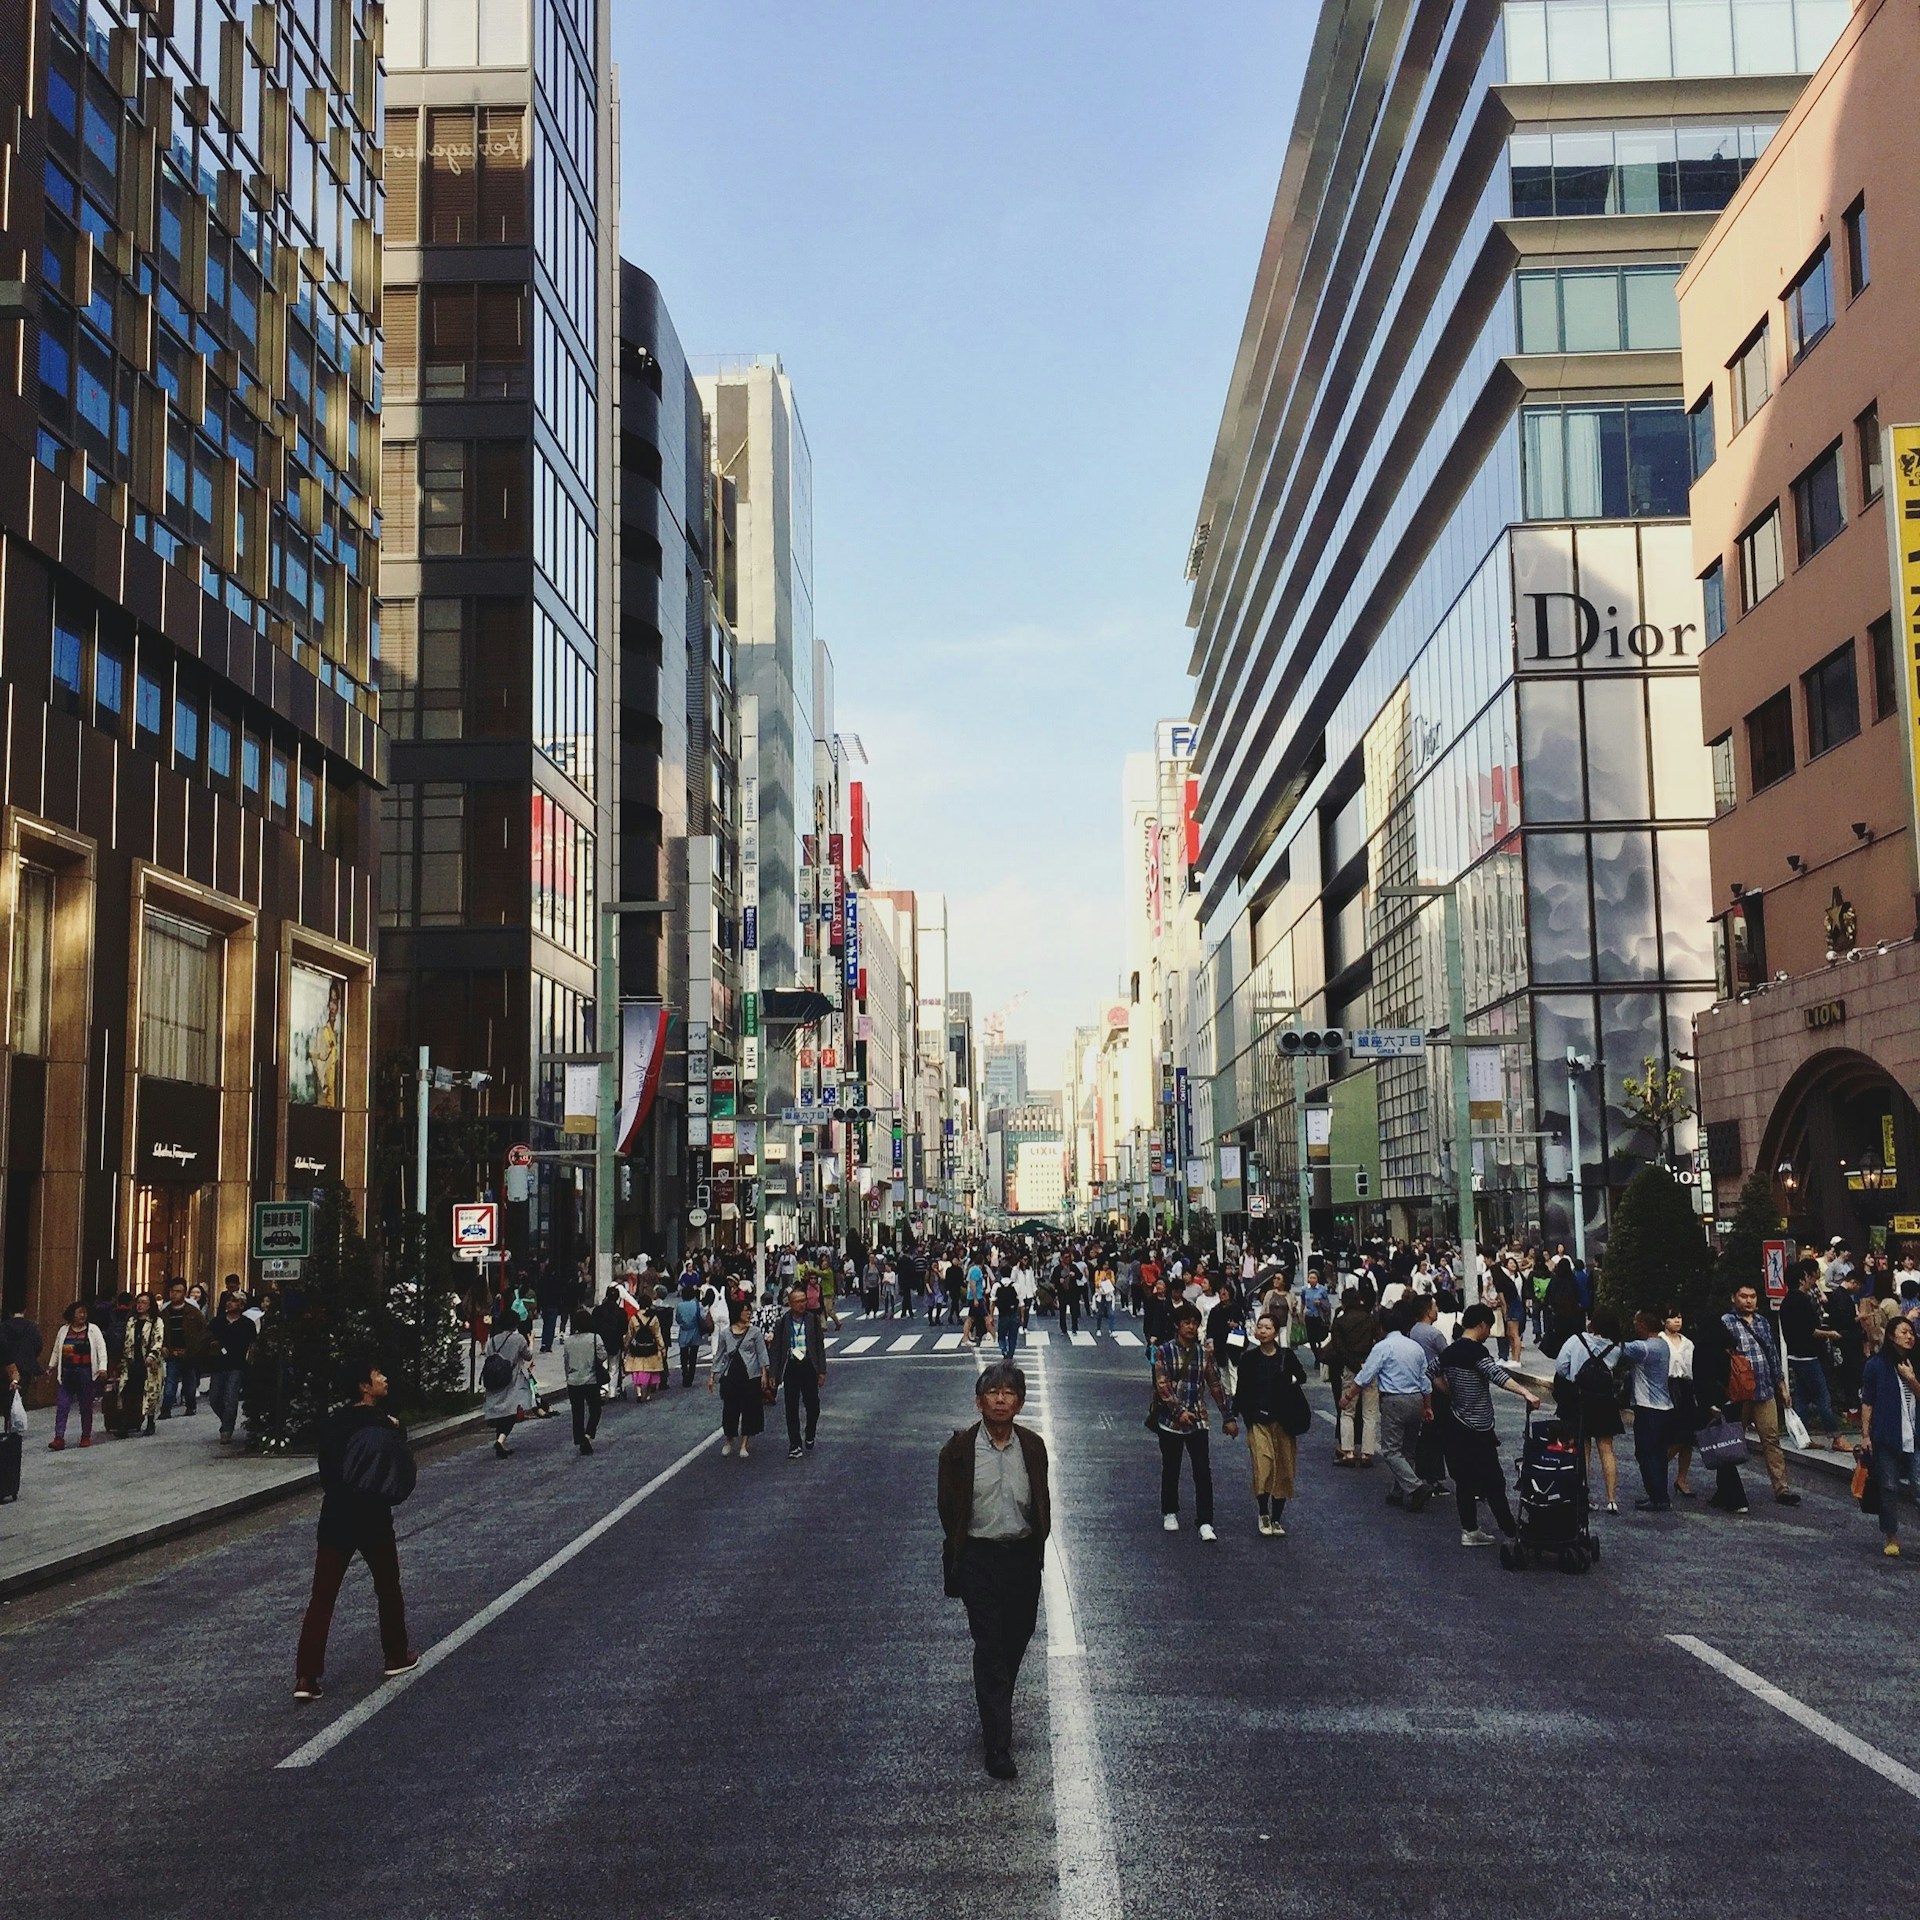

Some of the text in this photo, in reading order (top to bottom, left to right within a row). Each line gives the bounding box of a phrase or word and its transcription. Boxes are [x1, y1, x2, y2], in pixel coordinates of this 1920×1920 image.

[1523, 592, 1697, 660] Dior
[1412, 714, 1441, 775] Dior
[846, 897, 857, 975] アートネイチャー
[1804, 1000, 1845, 1029] LION
[1358, 1036, 1421, 1047] 銀座六丁目
[1030, 1146, 1058, 1155] LIXIL
